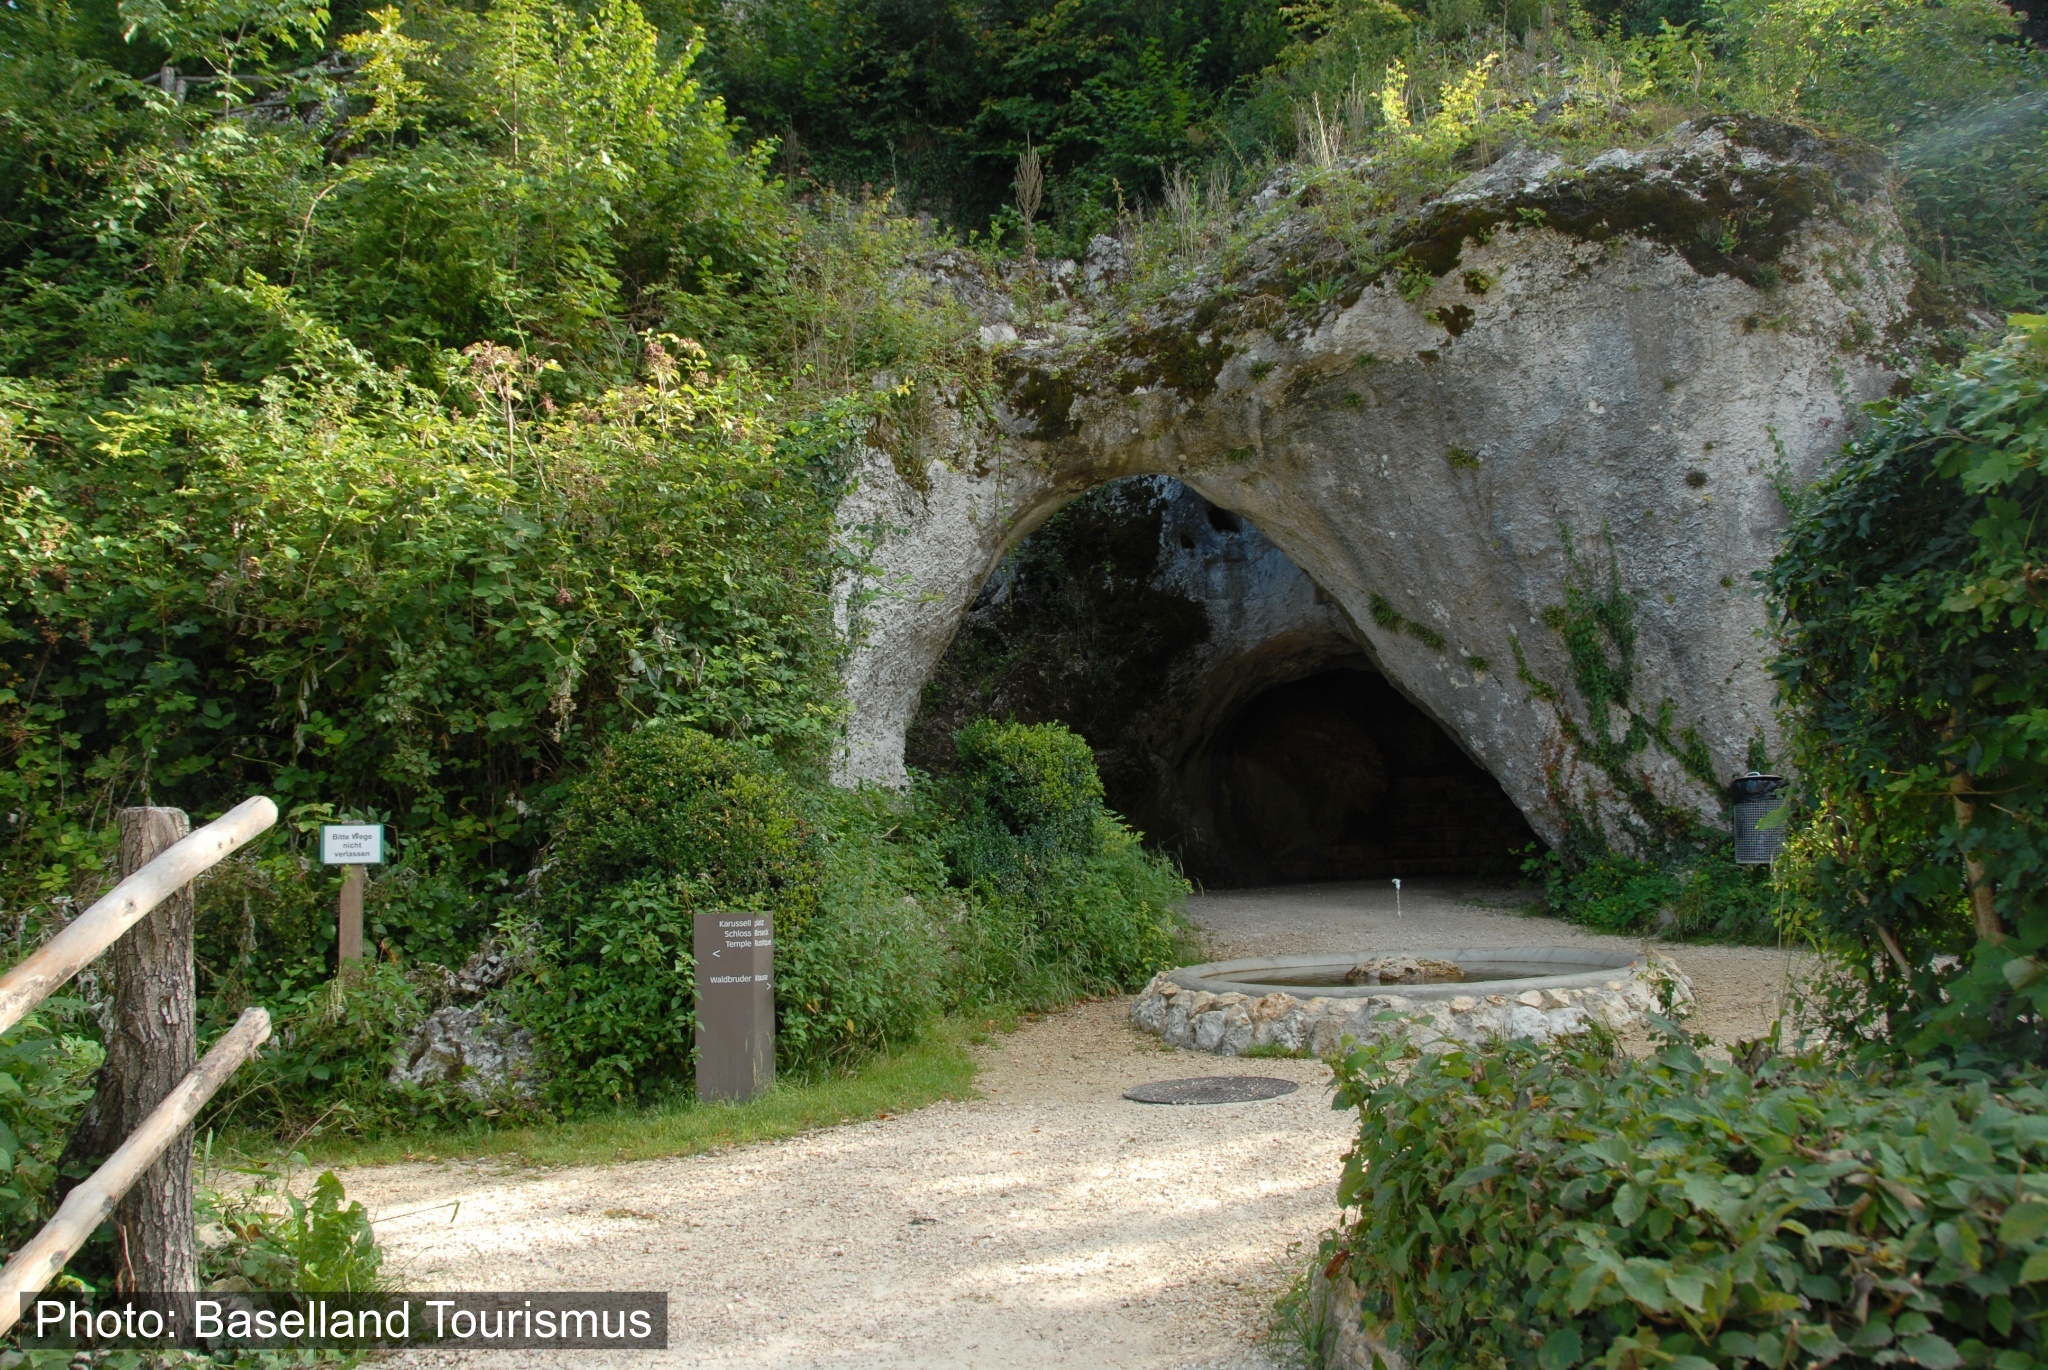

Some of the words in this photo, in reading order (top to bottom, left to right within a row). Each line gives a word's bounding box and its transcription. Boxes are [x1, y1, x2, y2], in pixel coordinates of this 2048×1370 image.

[352, 833, 373, 841] Wege
[719, 919, 752, 928] Karussell
[724, 930, 752, 938] Schloss
[725, 940, 752, 948] Temple
[709, 975, 752, 984] Waldbruder
